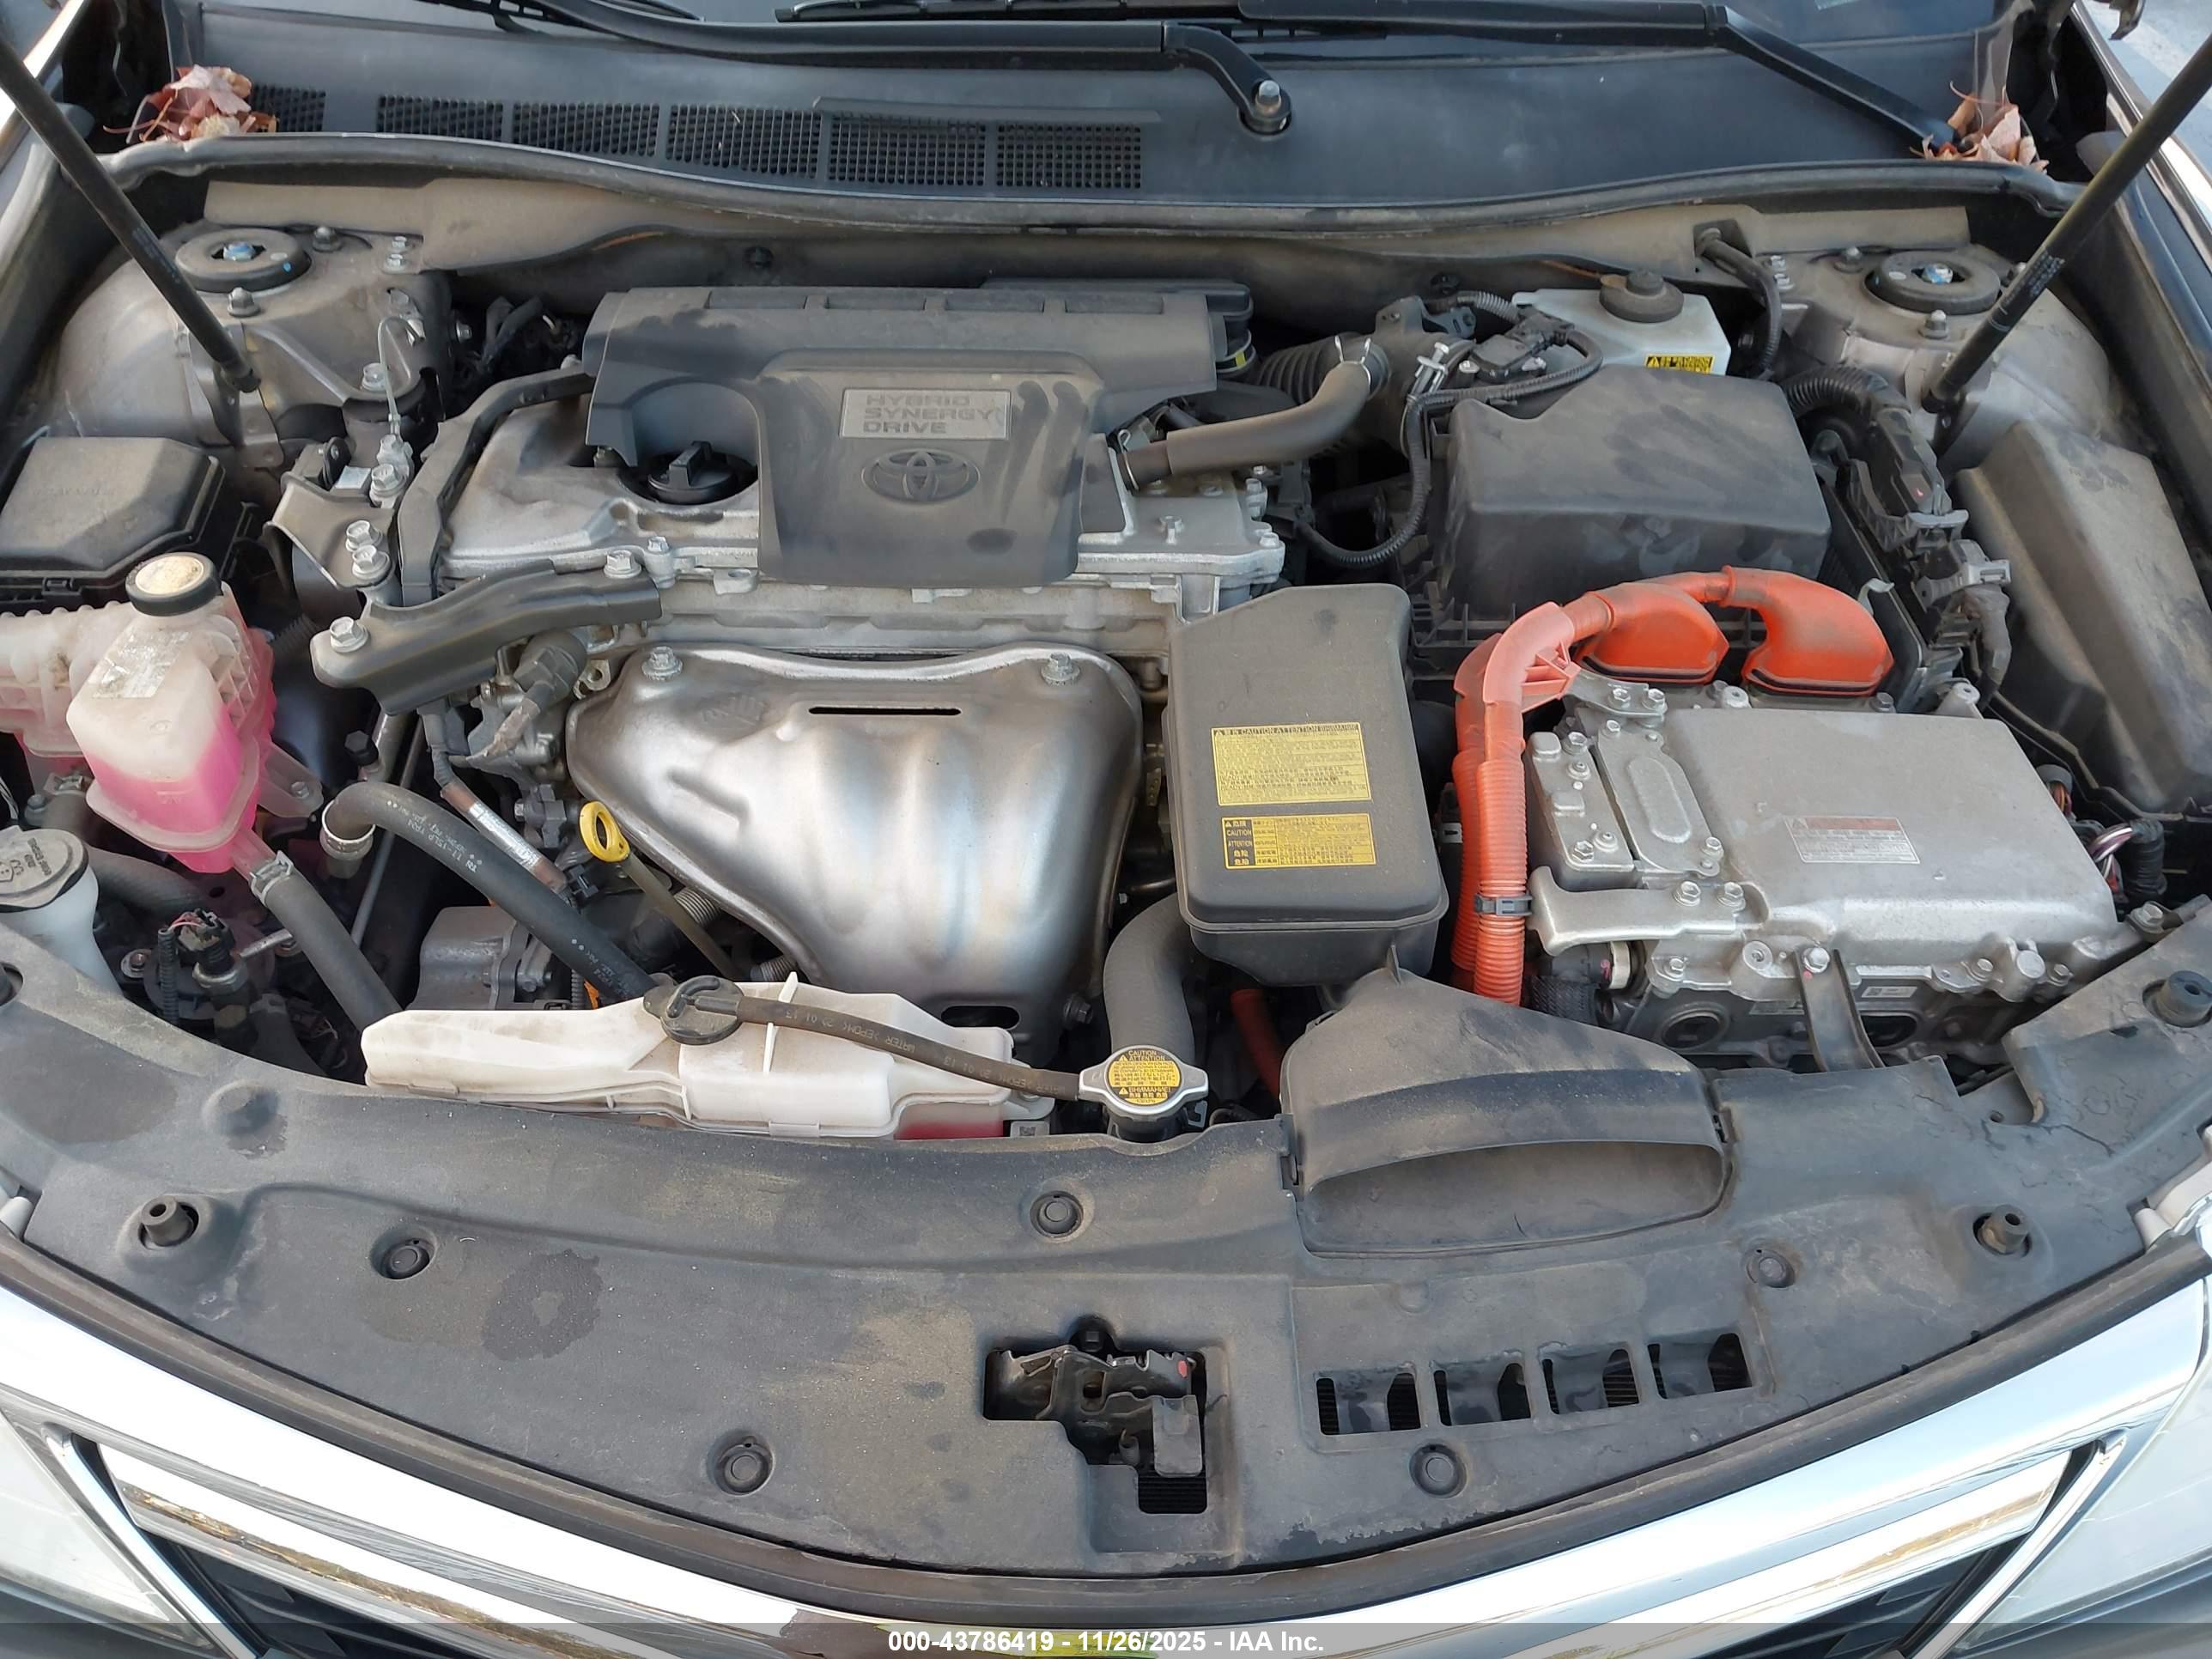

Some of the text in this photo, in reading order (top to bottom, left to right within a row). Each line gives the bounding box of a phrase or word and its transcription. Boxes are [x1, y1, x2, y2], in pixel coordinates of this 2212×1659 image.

[866, 394, 970, 407] HYBRID
[864, 407, 994, 421] SYNERGY
[862, 421, 947, 434] DRIVE
[1227, 829, 1252, 837] CAUTION
